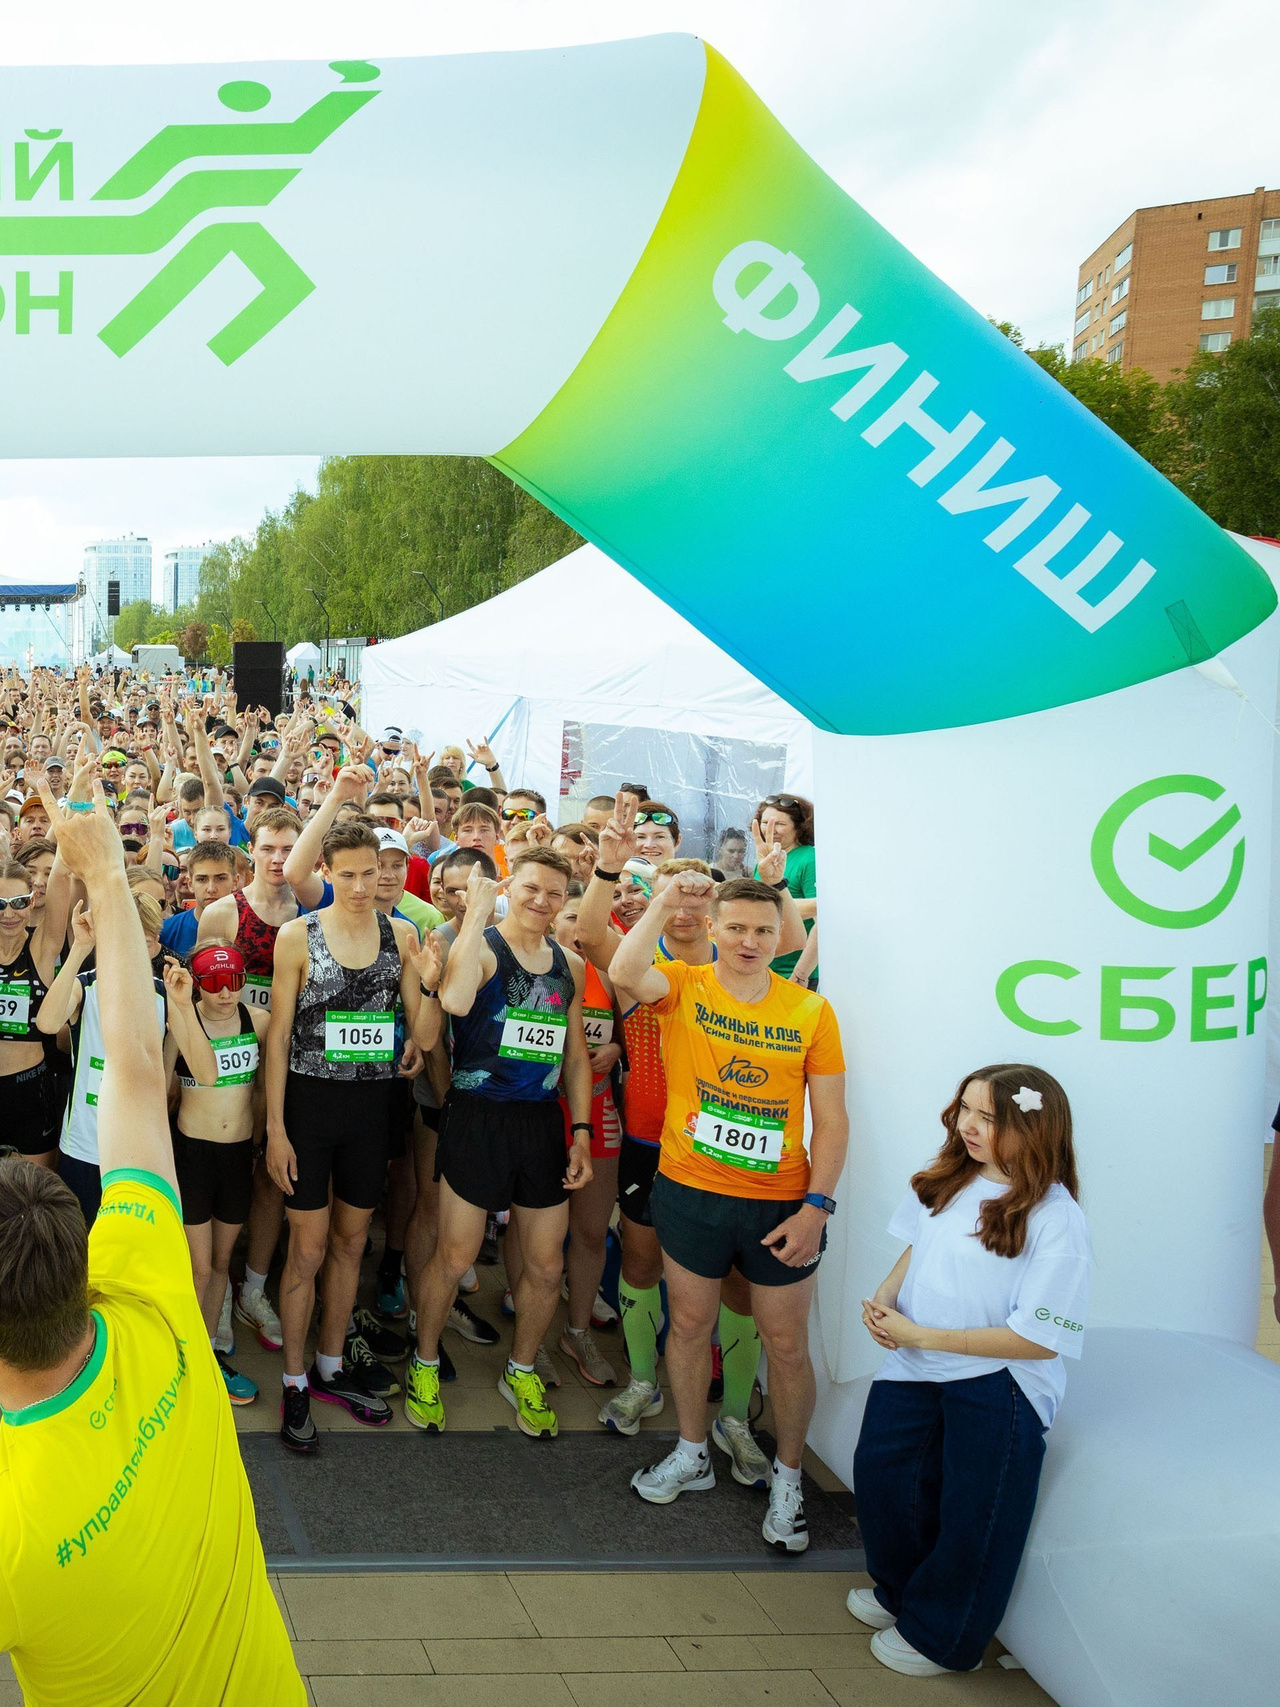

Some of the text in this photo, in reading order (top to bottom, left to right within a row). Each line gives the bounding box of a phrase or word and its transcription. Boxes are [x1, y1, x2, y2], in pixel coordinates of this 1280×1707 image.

[712, 240, 1157, 634] ФИНИШ
[995, 956, 1268, 1042] СБЕР
[339, 1028, 382, 1044] 1056
[518, 1026, 554, 1046] 1425
[764, 1026, 802, 1044] КЛУБ
[220, 1050, 251, 1070] 509
[16, 1069, 37, 1084] NIKE
[714, 1124, 768, 1154] 1801
[1054, 1316, 1084, 1332] СБЕР
